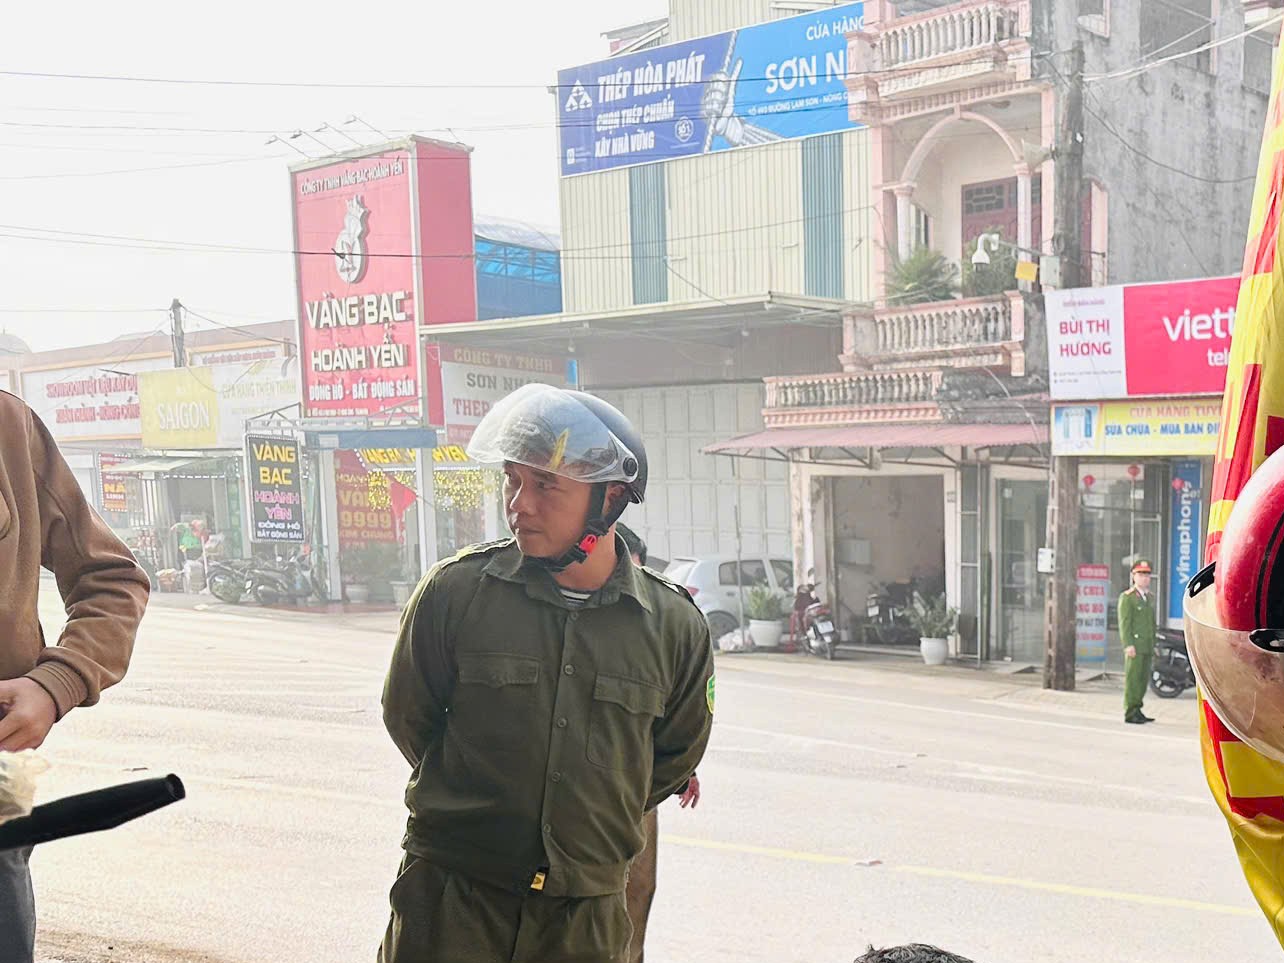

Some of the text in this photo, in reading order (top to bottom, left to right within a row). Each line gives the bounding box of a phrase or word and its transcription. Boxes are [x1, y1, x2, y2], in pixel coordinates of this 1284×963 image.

[806, 20, 830, 40] CỬA
[598, 51, 705, 103] THÉP HÒA PHÁT
[765, 56, 816, 94] SƠN
[305, 290, 409, 330] VÀNG BẠC
[312, 342, 366, 372] HOÀNH
[158, 402, 209, 430] SAIGON
[1160, 423, 1180, 435] MUA
[253, 441, 297, 463] VÀNG
[259, 466, 293, 488] BẠC
[254, 489, 299, 505] HOÀNH
[341, 511, 391, 528] 9999
